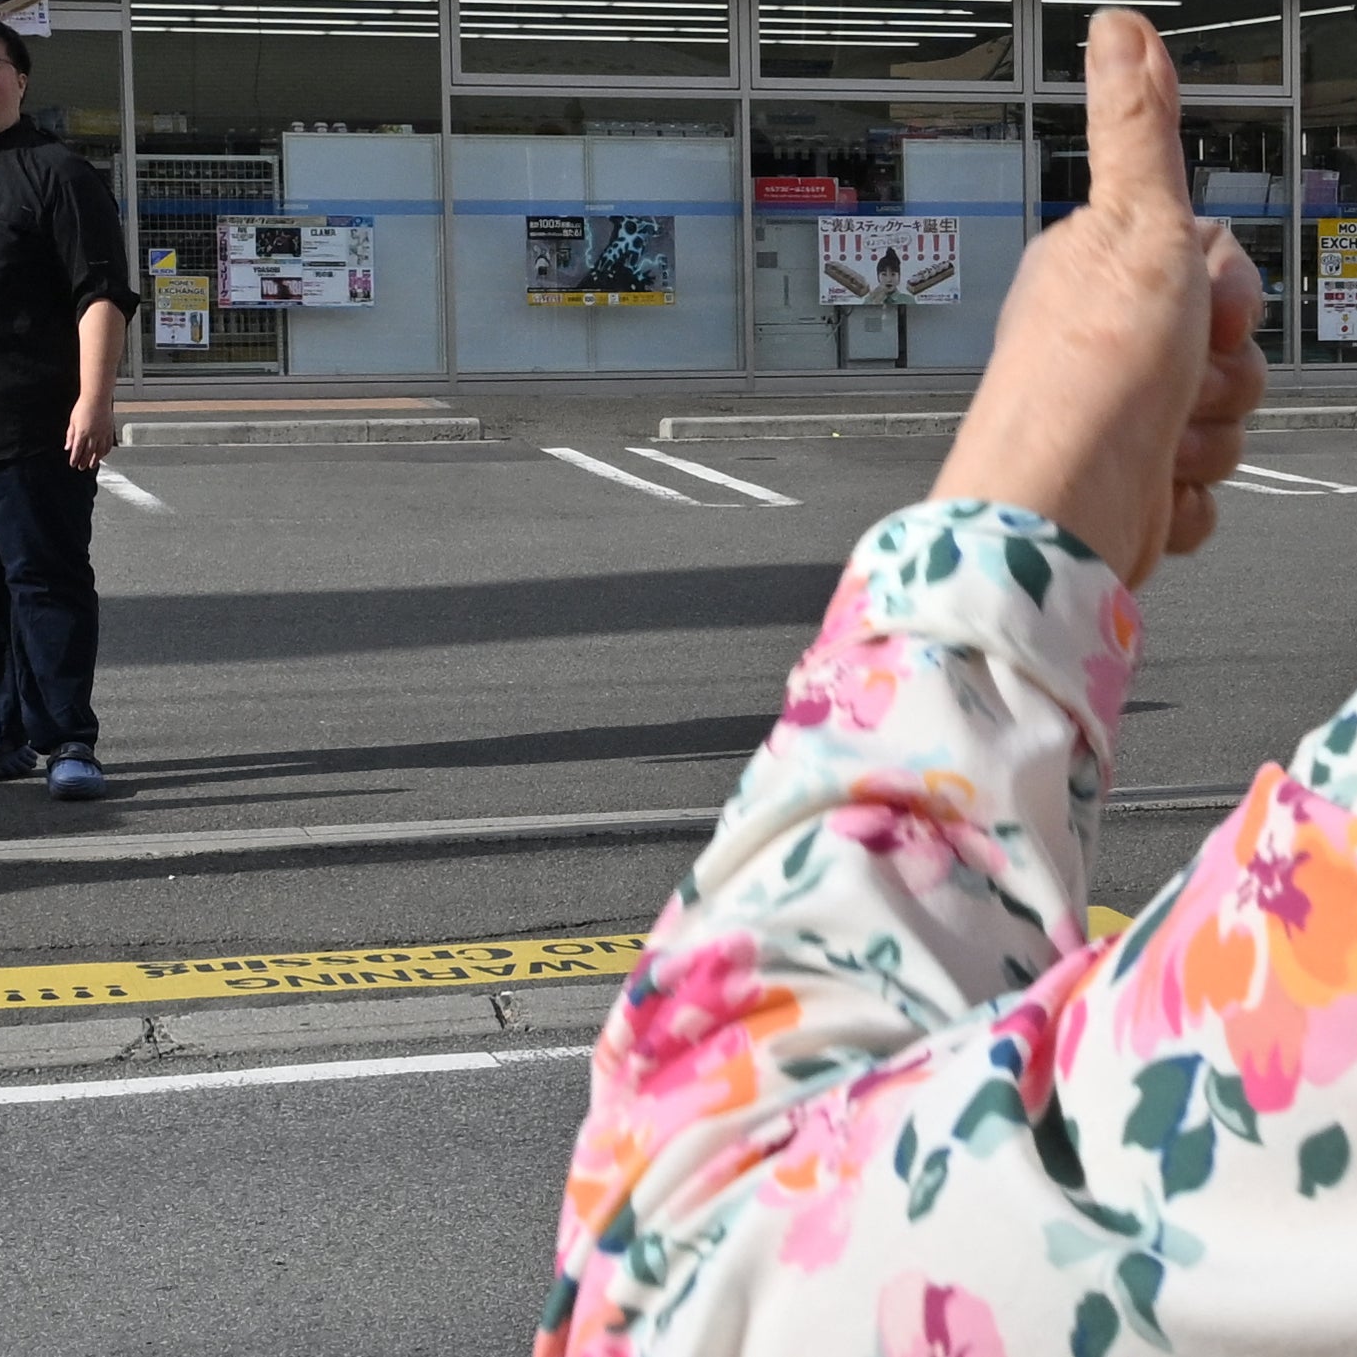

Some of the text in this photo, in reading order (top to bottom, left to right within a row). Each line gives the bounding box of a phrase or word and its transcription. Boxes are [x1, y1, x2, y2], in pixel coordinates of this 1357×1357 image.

[158, 287, 205, 295] EXCHANGE
[136, 938, 647, 980] NO Crossing
[223, 958, 599, 991] WARNING
